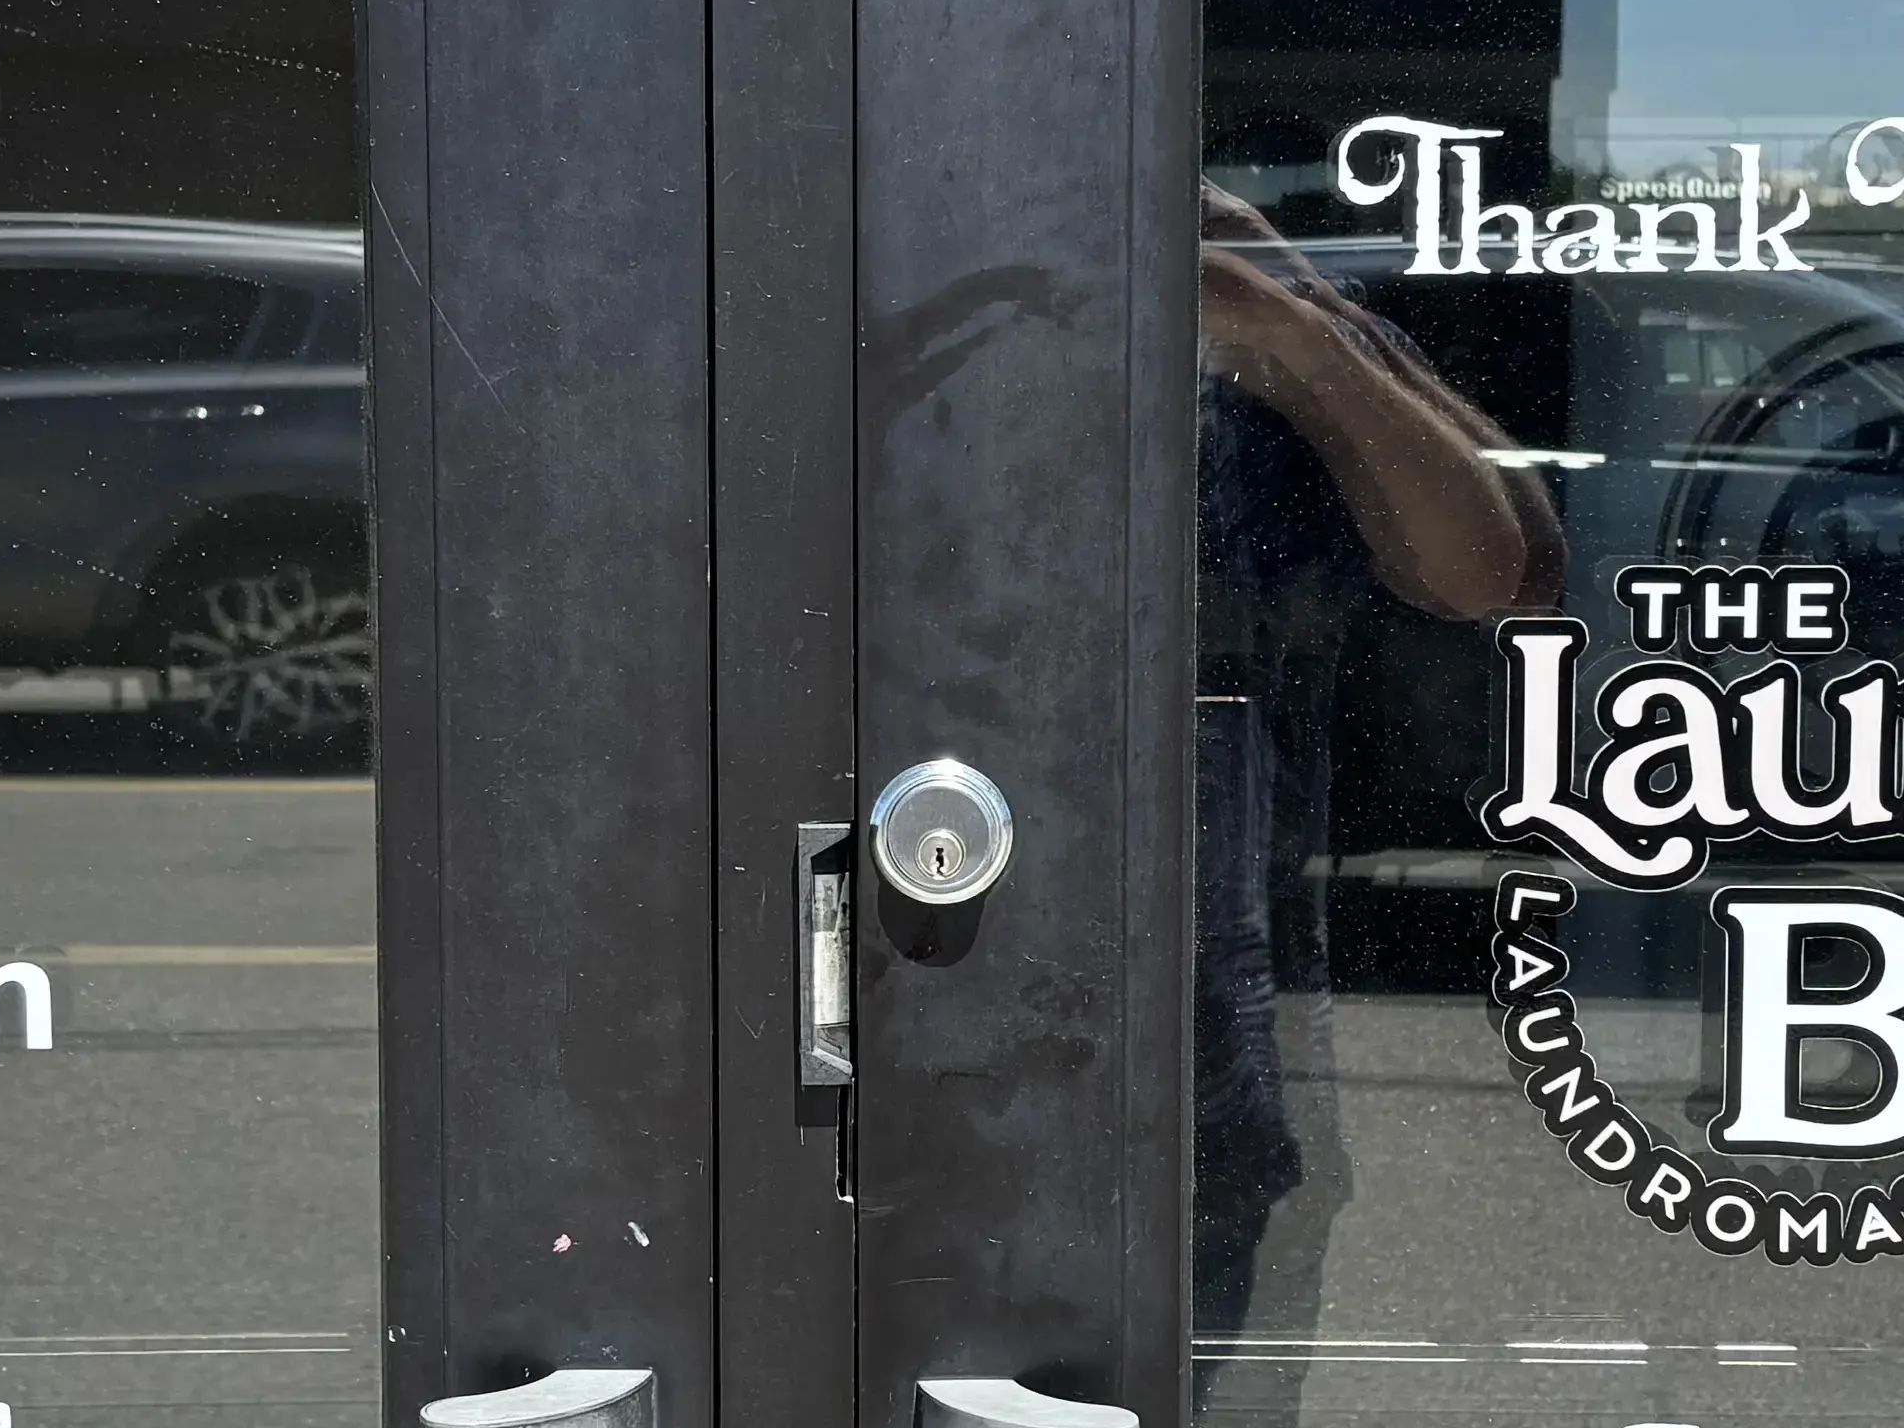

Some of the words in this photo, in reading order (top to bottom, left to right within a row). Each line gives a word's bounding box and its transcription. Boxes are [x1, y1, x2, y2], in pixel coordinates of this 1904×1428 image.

[1339, 117, 1814, 274] Thank
[1599, 174, 1684, 202] Speed
[1686, 175, 1771, 201] Quen
[1631, 582, 1834, 639] THE
